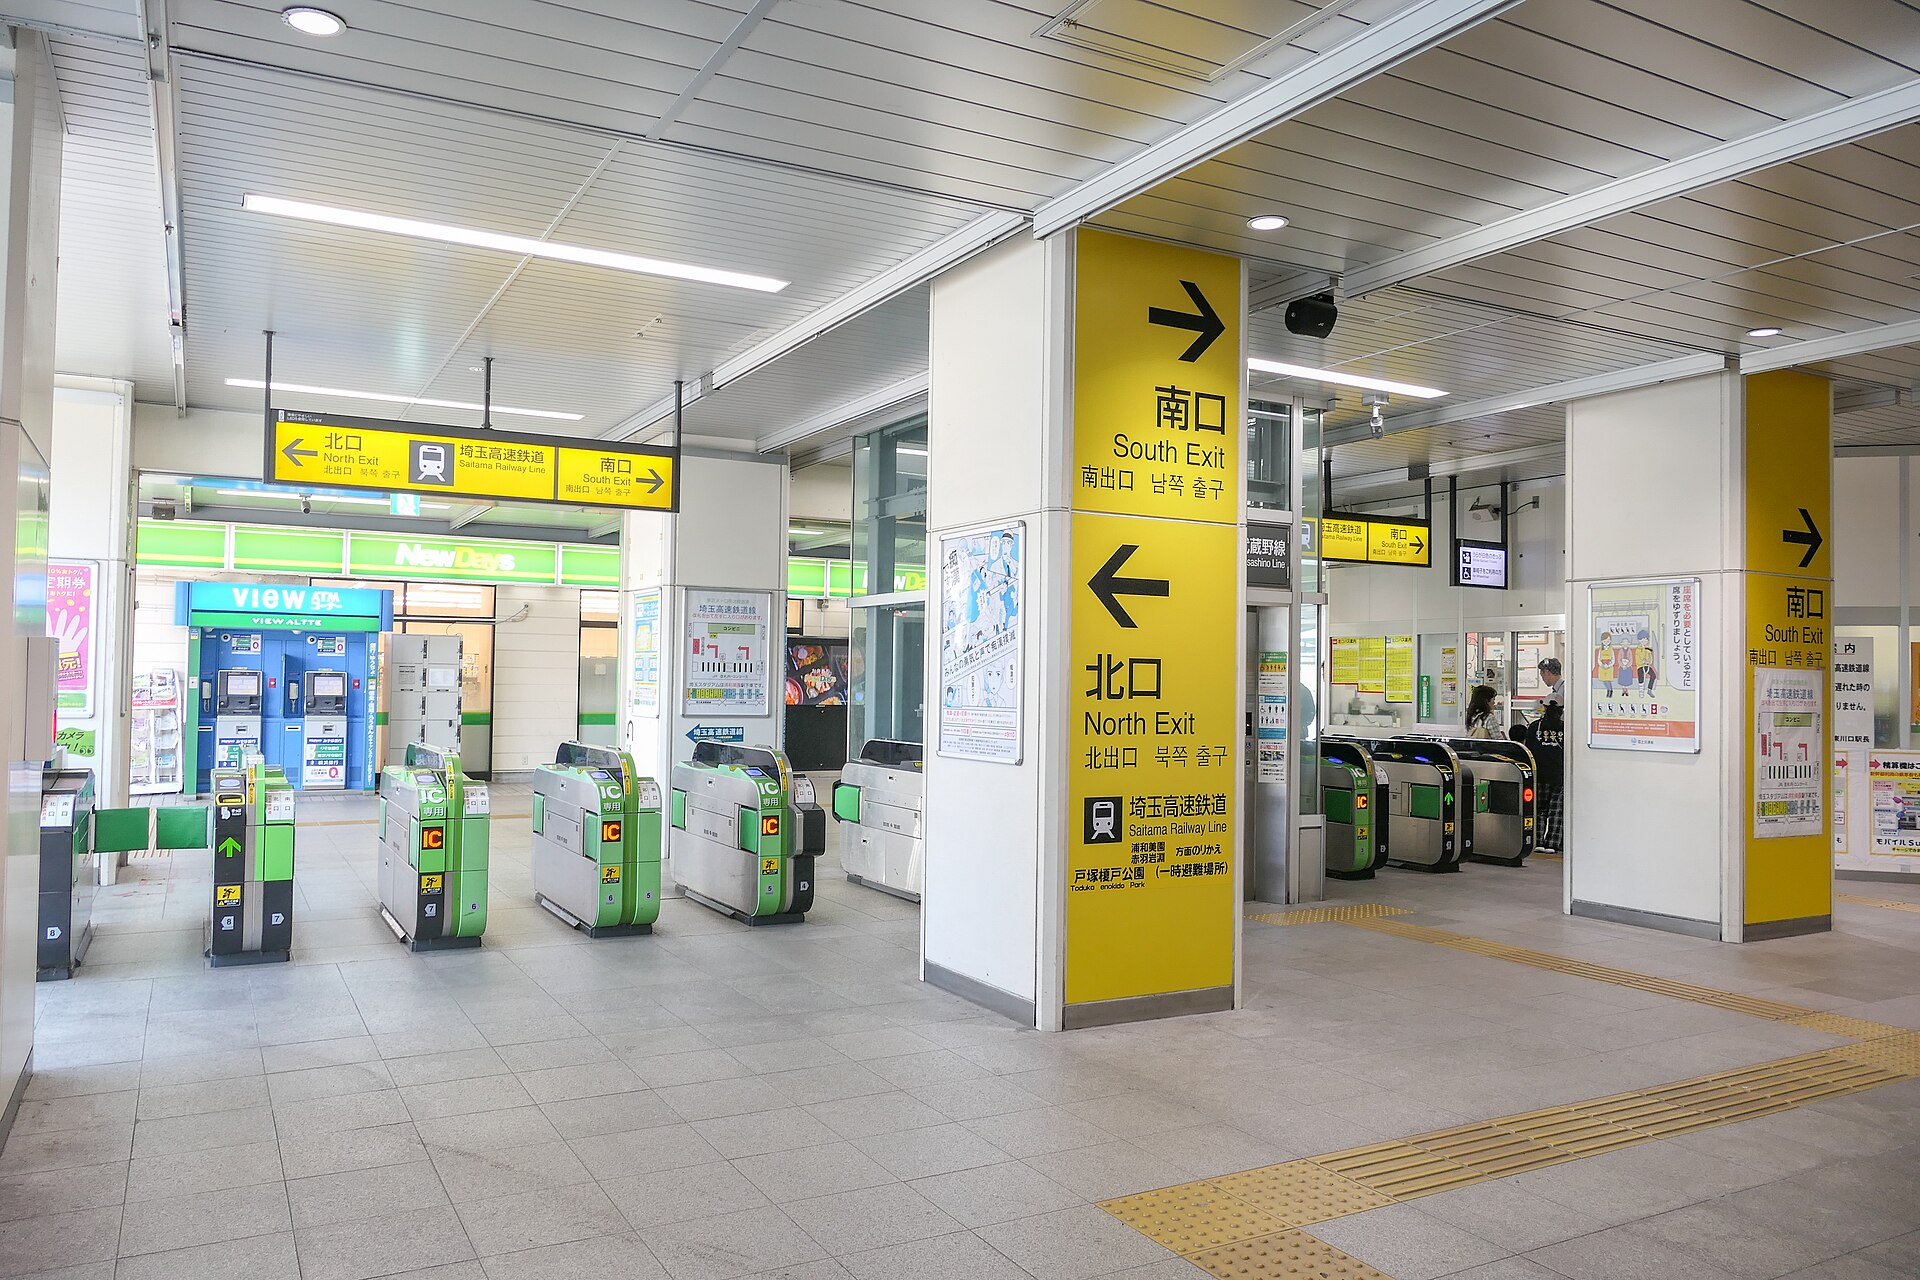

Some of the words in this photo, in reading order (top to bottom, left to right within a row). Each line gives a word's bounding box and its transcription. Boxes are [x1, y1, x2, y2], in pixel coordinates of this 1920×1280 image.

[1155, 385, 1226, 435] 南口
[325, 433, 362, 450] 北口
[324, 452, 355, 465] North
[358, 456, 379, 466] Exit
[459, 444, 545, 463] 埼玉高速鉄道
[1114, 434, 1177, 463] South
[1186, 442, 1225, 469] Exit
[324, 465, 352, 475] 北出口
[459, 459, 493, 470] Saitama
[495, 462, 526, 474] Railway
[529, 465, 546, 474] Line
[600, 457, 632, 474] 南口
[583, 473, 610, 485] South
[613, 475, 631, 486] Exit
[1082, 465, 1134, 491] 南出口
[1151, 473, 1184, 496] 남쪽
[1192, 477, 1225, 500] 출구
[565, 484, 590, 495] 南出口
[1390, 528, 1407, 540] 南口
[1246, 537, 1286, 557] 蔵野線
[1381, 540, 1396, 549] South
[1398, 541, 1407, 550] Exit
[394, 542, 517, 571] NewDays
[1272, 558, 1286, 569] Line
[699, 604, 757, 615] 埼玉高速鉄道線
[1786, 585, 1824, 620] 南口
[1672, 585, 1681, 665] 席をゆずりましょう。
[1683, 585, 1692, 687] 座席を必要としている方に
[1765, 623, 1799, 643] South
[1802, 626, 1824, 645] Exit
[1749, 648, 1777, 666] 南出口
[1784, 650, 1802, 667] 남쪽
[1806, 650, 1823, 667] 출구
[1085, 653, 1162, 701] 北口
[1766, 687, 1814, 700] 埼玉高速鉄道線
[693, 727, 743, 736] 埼玉高速鉄道線
[1084, 711, 1146, 736] North
[1155, 711, 1195, 736] Exit
[1084, 746, 1138, 770] 北出口
[1154, 746, 1188, 769] 북쪽
[1195, 745, 1229, 767] 출구
[421, 786, 446, 804] IC
[600, 784, 622, 800] IC
[759, 782, 780, 796] IC
[1129, 794, 1227, 819] 埼玉高速鉄道
[603, 823, 621, 841] IC
[762, 818, 779, 835] IC
[1129, 823, 1168, 837] Saitama
[1170, 822, 1206, 837] Railway
[1209, 820, 1227, 834] Line
[422, 829, 443, 849] IC
[1131, 841, 1166, 853] 浦和美園
[1175, 844, 1222, 857] 方面のりかえ
[1074, 866, 1145, 884] 戸塚榎戸公園
[471, 902, 477, 911] 6
[607, 894, 613, 903] 6
[428, 905, 434, 913] 7
[274, 914, 281, 923] 7
[50, 927, 56, 937] 8
